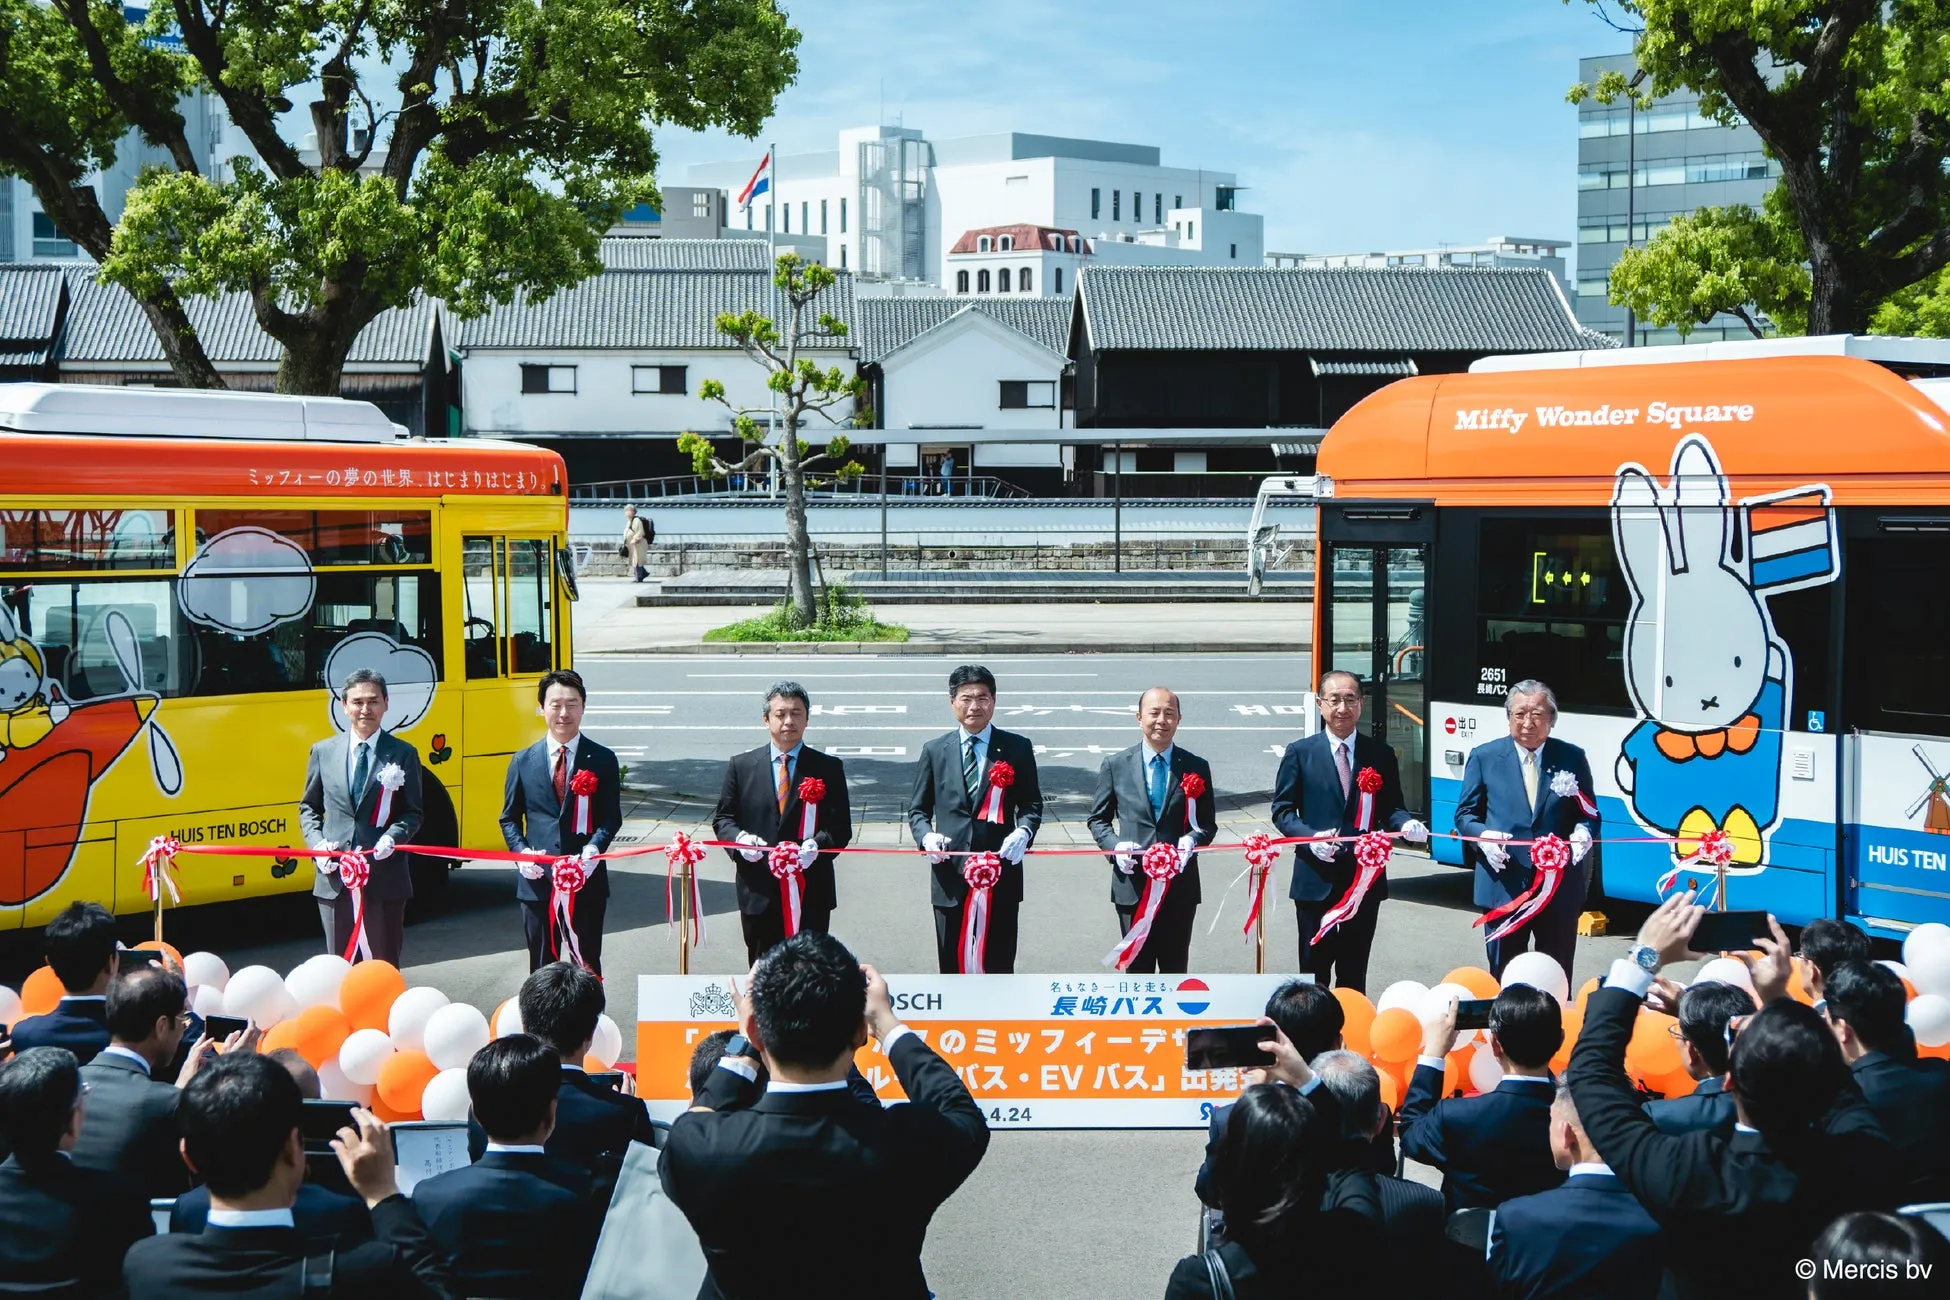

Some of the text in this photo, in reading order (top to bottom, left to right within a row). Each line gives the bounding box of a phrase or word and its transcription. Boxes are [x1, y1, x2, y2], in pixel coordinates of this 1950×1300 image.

[1454, 401, 1754, 434] Miffy Wonder Square
[1481, 667, 1506, 682] 2651
[1477, 683, 1508, 696] 長崎バス
[1458, 716, 1477, 730] 出口
[1461, 730, 1474, 738] EXIT
[170, 818, 286, 843] HUIS TEN BOSCH
[1868, 844, 1947, 871] HUIS TEN
[1050, 981, 1174, 993] 名もなき一日を走る。
[889, 993, 942, 1010] SCH
[1050, 995, 1163, 1016] 長崎バス
